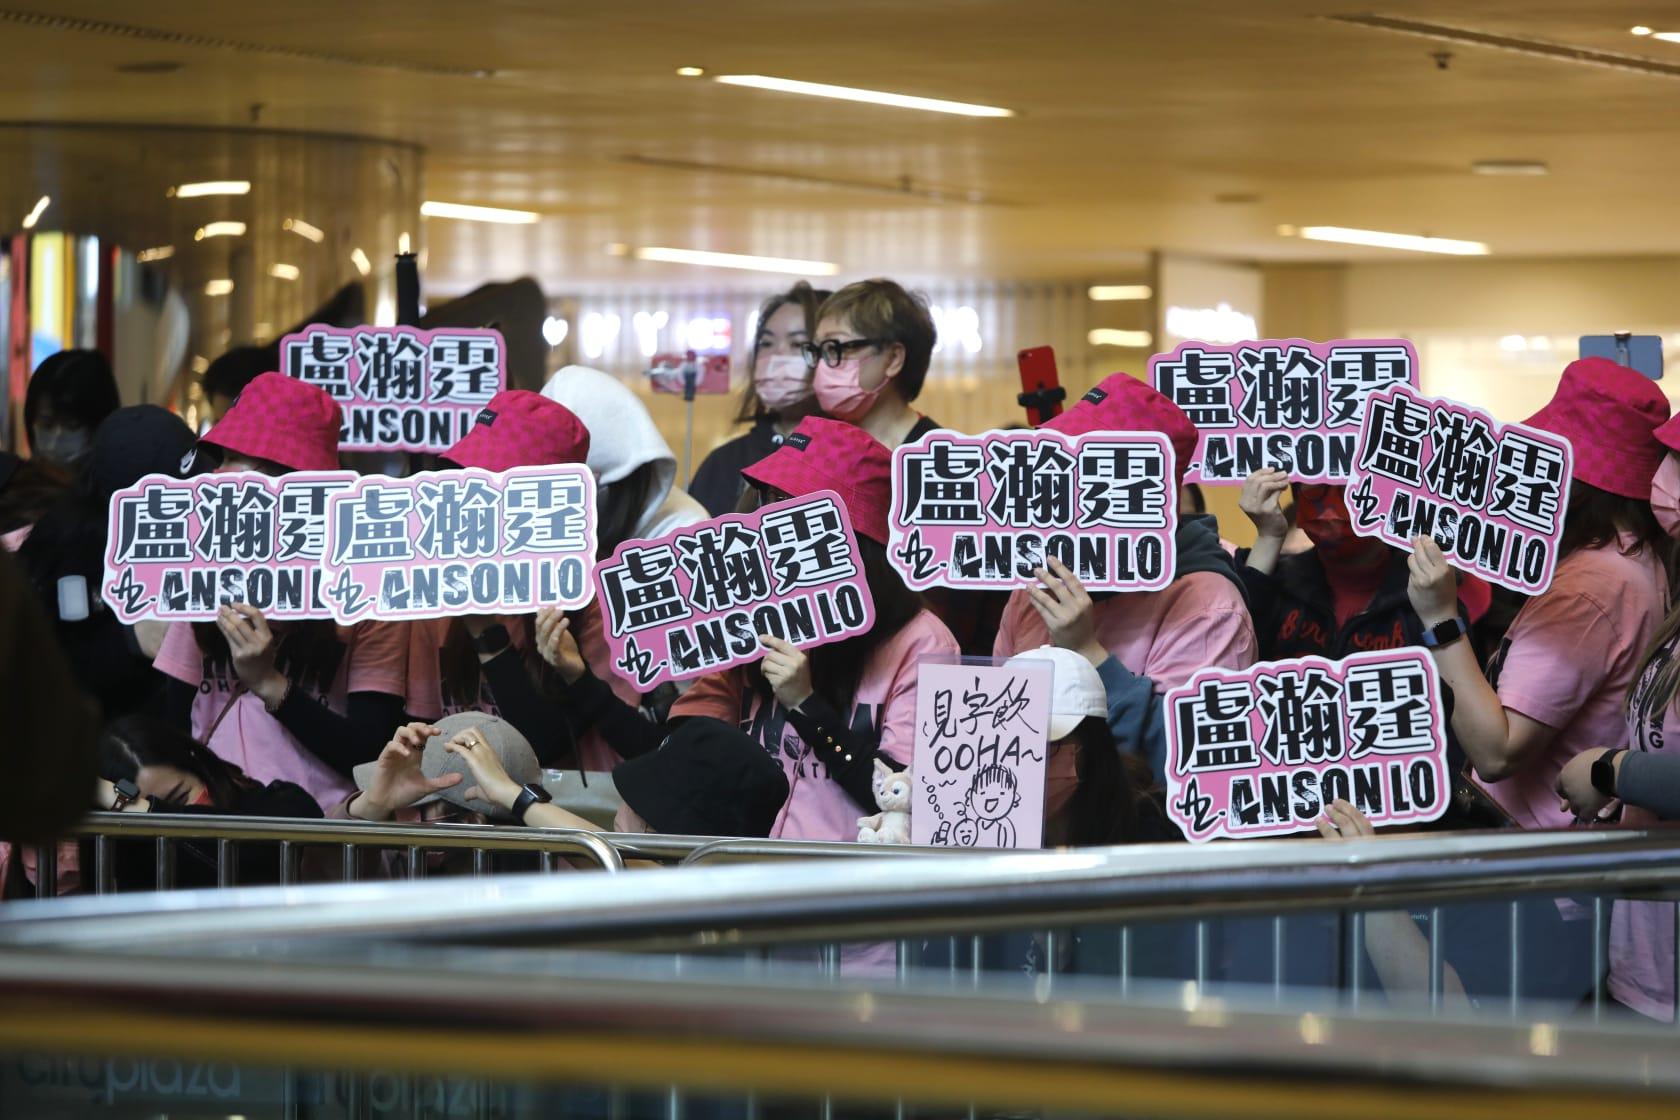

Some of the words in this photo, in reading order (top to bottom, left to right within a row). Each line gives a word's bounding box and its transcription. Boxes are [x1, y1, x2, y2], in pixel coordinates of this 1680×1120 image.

[289, 334, 496, 402] 盧瀚霆
[339, 408, 451, 446] NSON
[1203, 433, 1356, 478] ANSON
[903, 443, 1167, 526] 盧瀚霆
[1361, 396, 1562, 534] 盧瀚霆
[117, 485, 326, 559] 盧瀚霆
[334, 474, 587, 563] 盧瀚霆
[1386, 491, 1507, 572] ANSON
[1507, 533, 1547, 585] LO
[159, 567, 303, 611] ANSON
[379, 561, 531, 610] ANSON
[540, 557, 583, 602] LO
[603, 500, 857, 636] 盧瀚霆
[949, 532, 1108, 580] ANSON
[1117, 534, 1163, 581] LO
[667, 597, 818, 675] ANSON
[815, 584, 865, 636] LO
[928, 675, 1040, 749] 見字飲
[1179, 663, 1434, 772] 盧瀚霆
[1230, 765, 1384, 828] ANSON
[1390, 760, 1436, 812] LO
